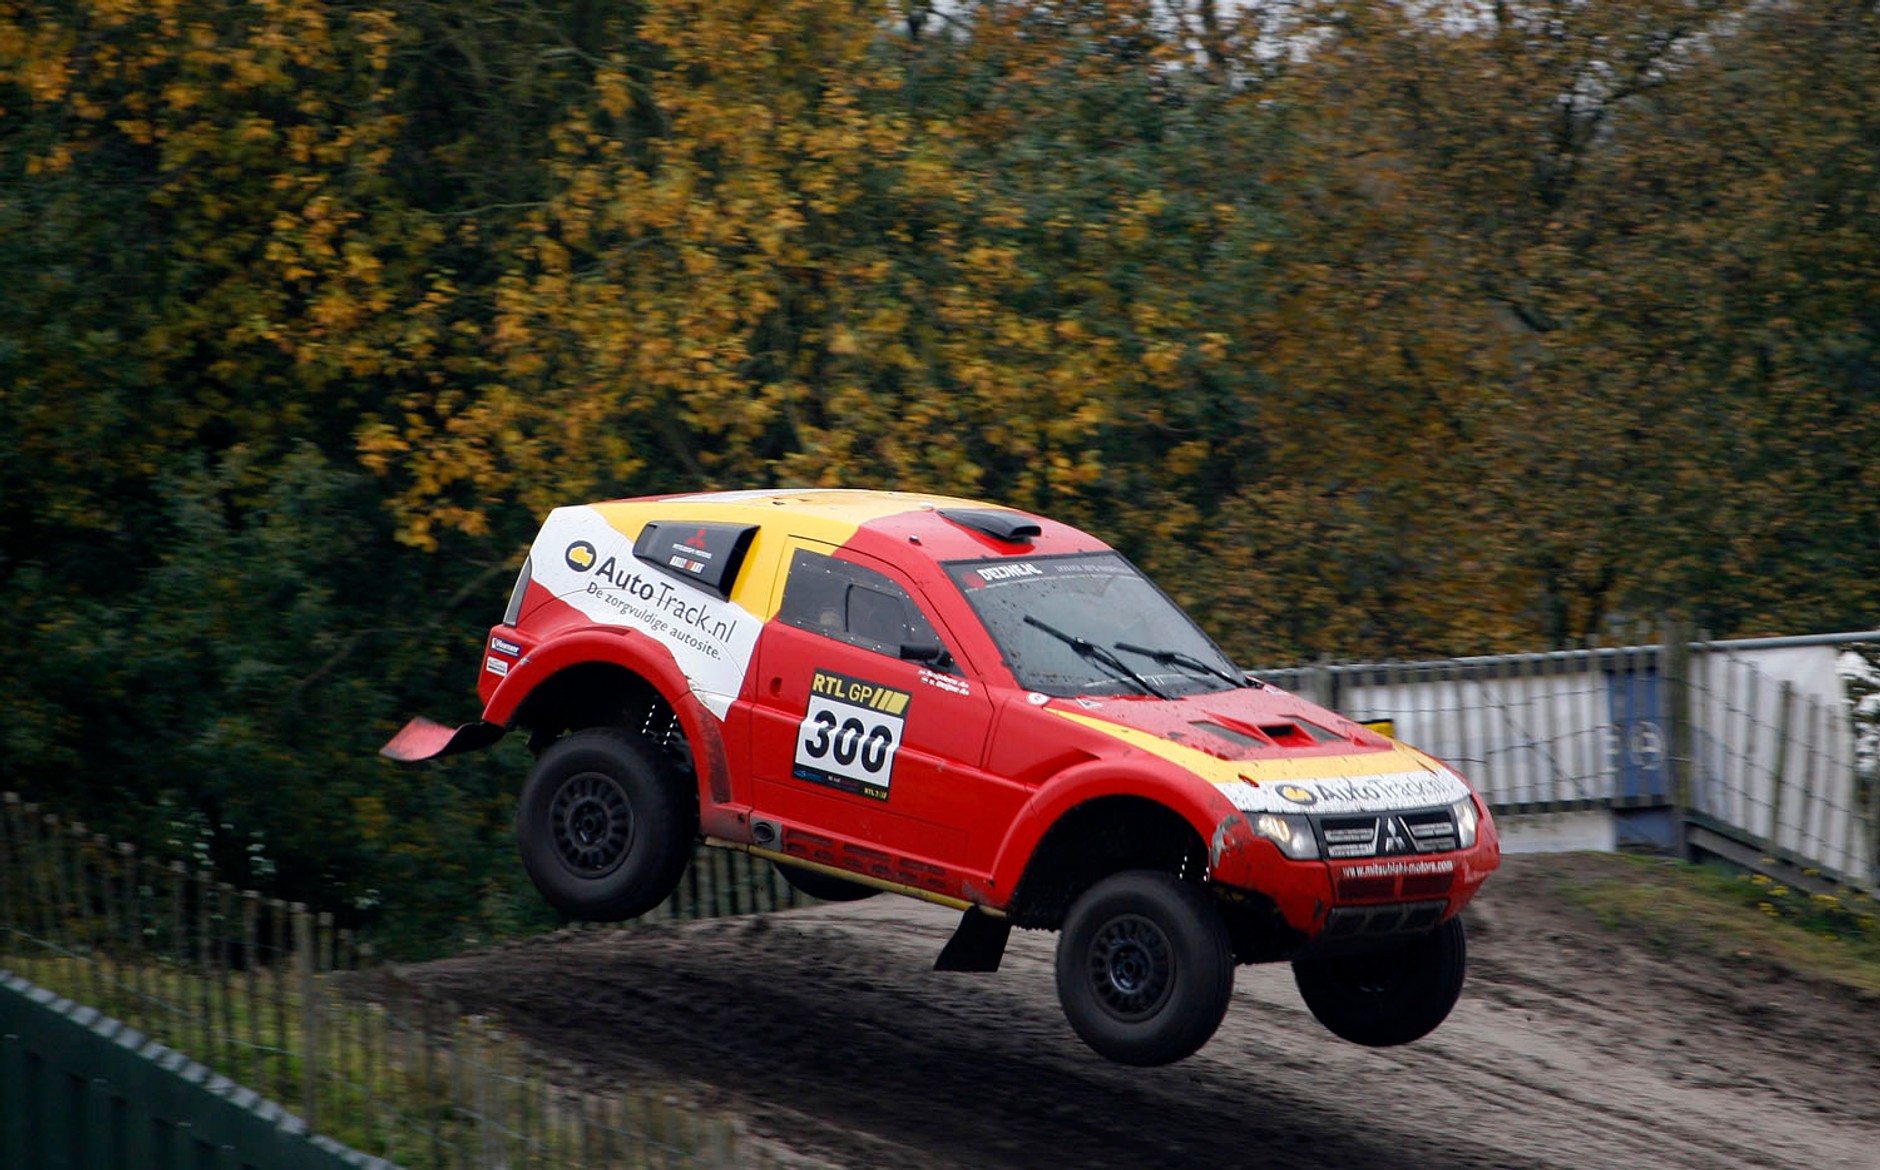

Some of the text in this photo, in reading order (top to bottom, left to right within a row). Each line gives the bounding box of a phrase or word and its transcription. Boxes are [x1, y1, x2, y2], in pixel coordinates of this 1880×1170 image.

[586, 582, 721, 660] De zorgvuldige autosite.
[595, 556, 738, 643] AutoTrack.nl
[812, 673, 873, 703] RTL GP
[805, 710, 892, 773] 300
